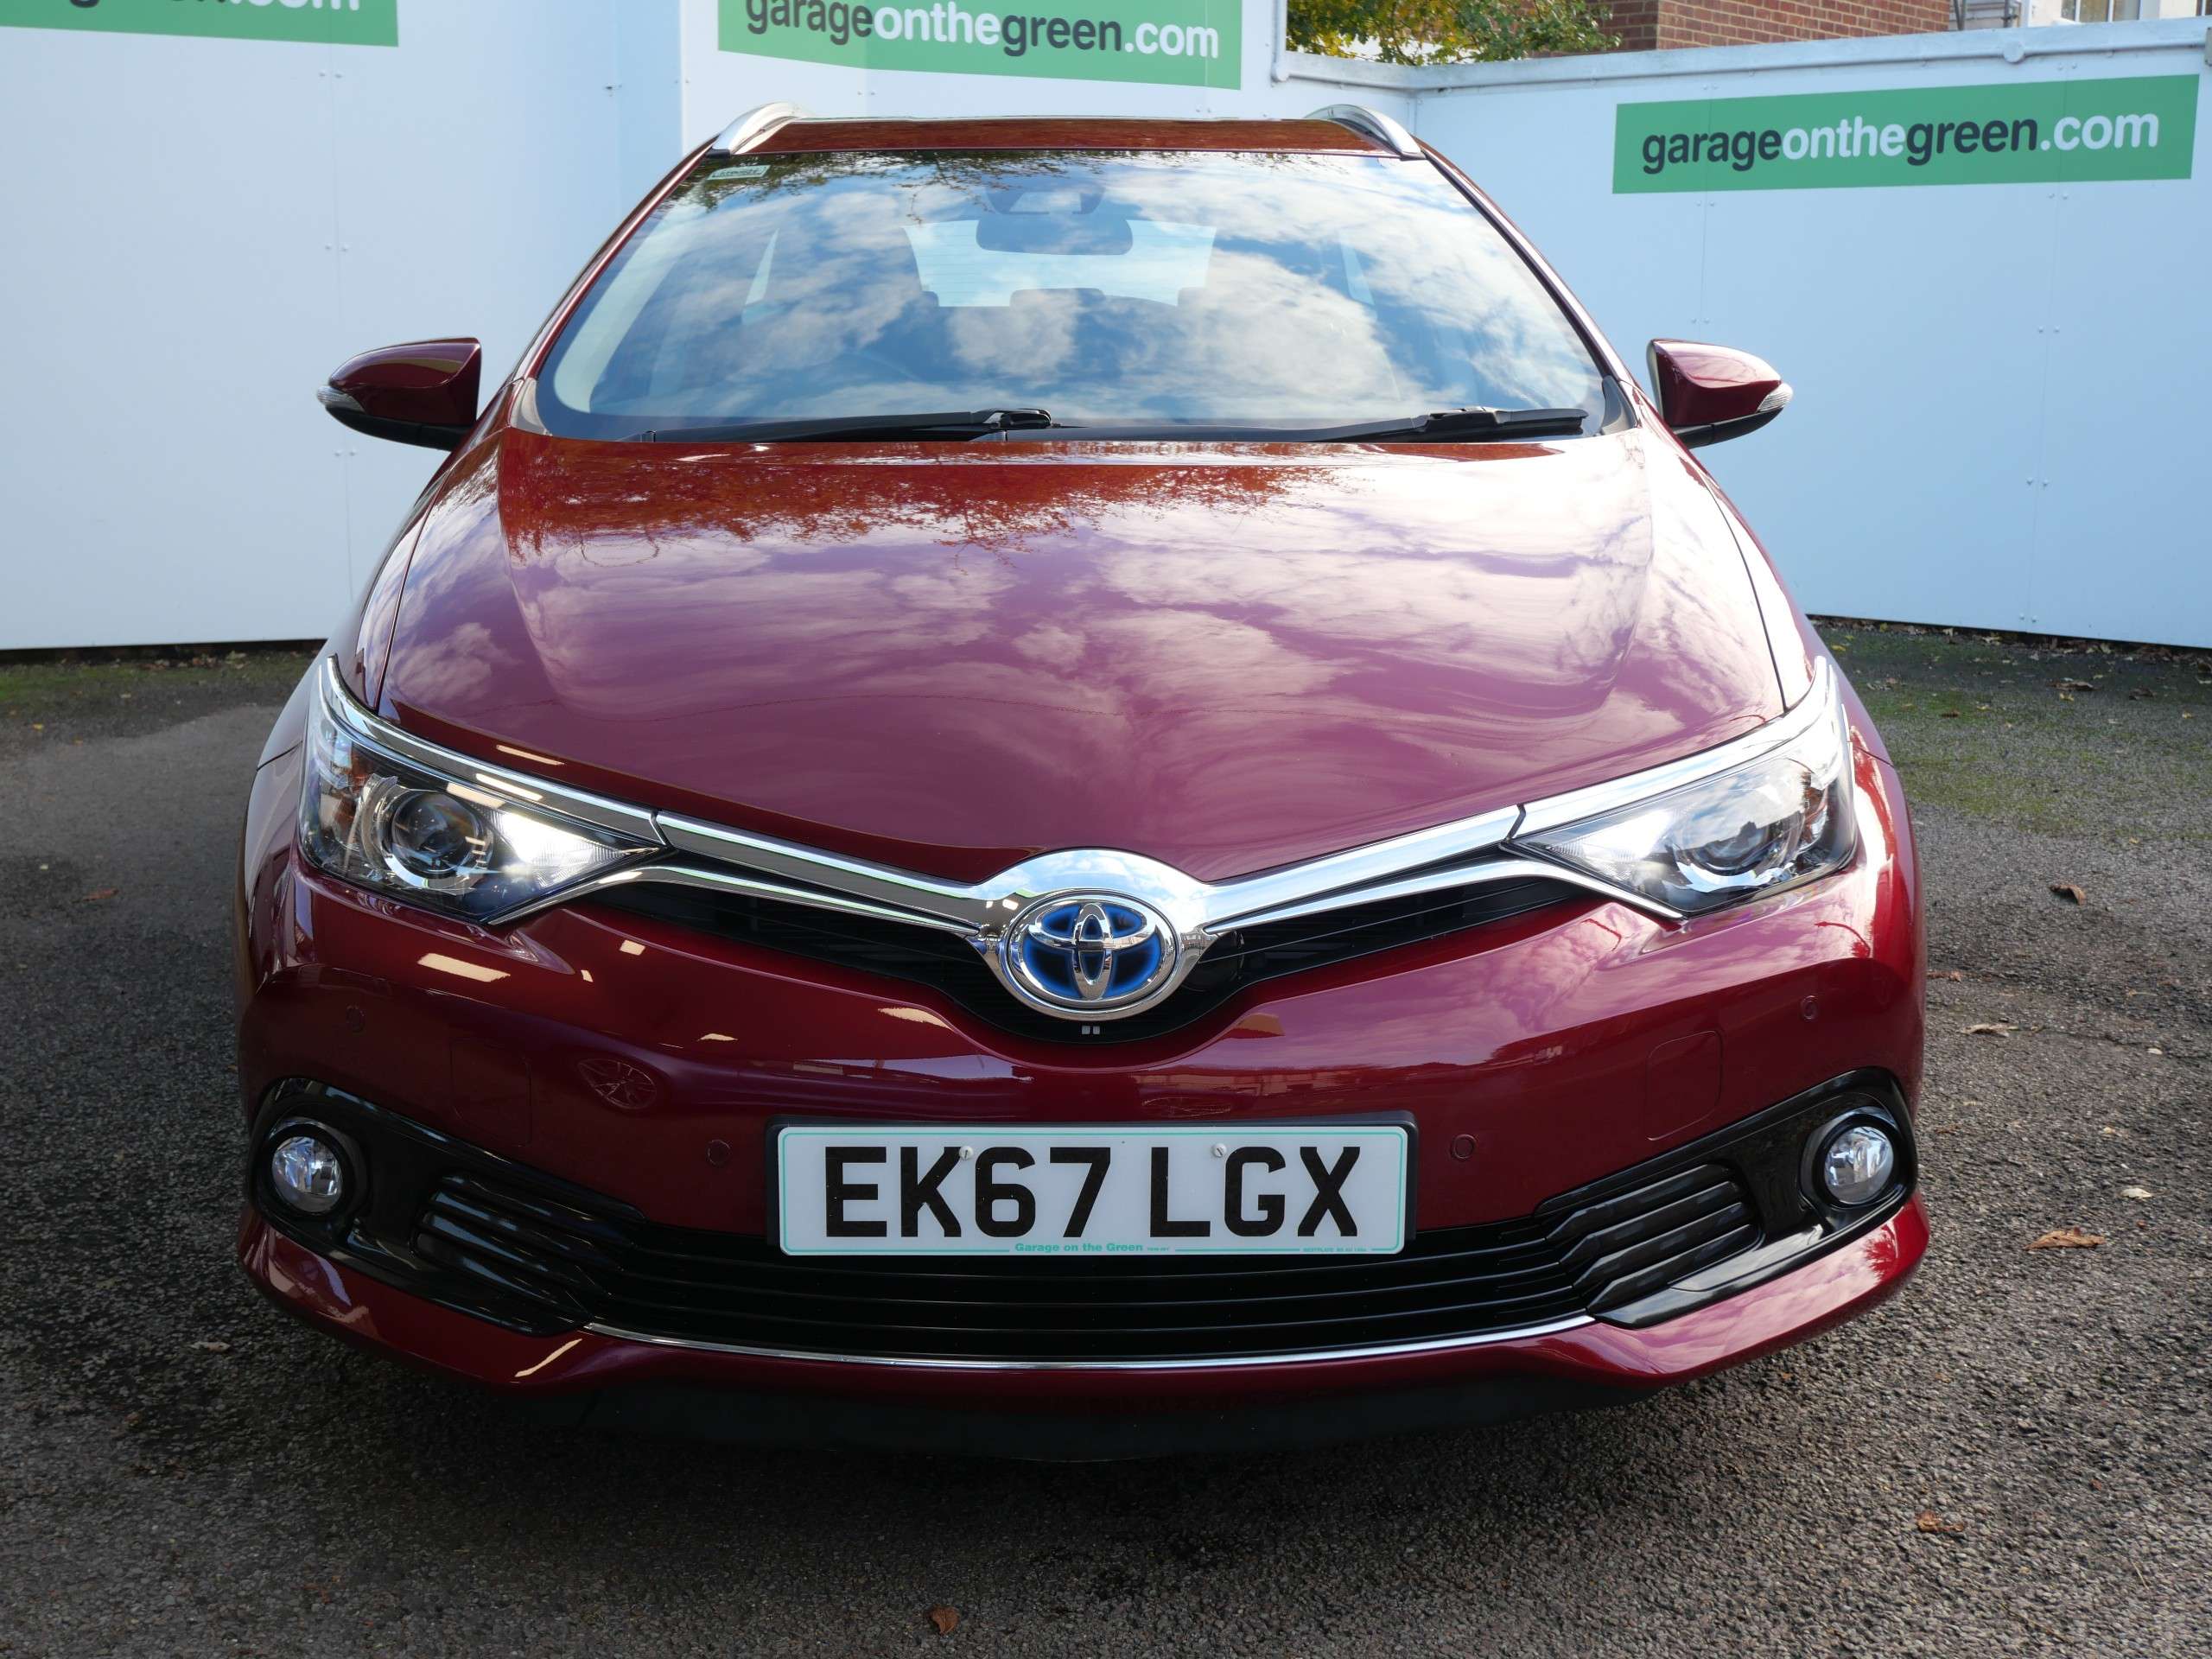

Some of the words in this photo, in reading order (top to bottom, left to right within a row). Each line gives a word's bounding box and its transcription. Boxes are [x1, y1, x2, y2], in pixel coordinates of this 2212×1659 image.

[746, 0, 1219, 58] garageonthegreen.com
[1642, 111, 2159, 175] garageonthegreen.com
[825, 1146, 1111, 1237] EK67
[1150, 1146, 1360, 1237] LGX
[1014, 1243, 1060, 1254] Garage
[1083, 1243, 1103, 1252] the
[1106, 1243, 1144, 1252] Green
